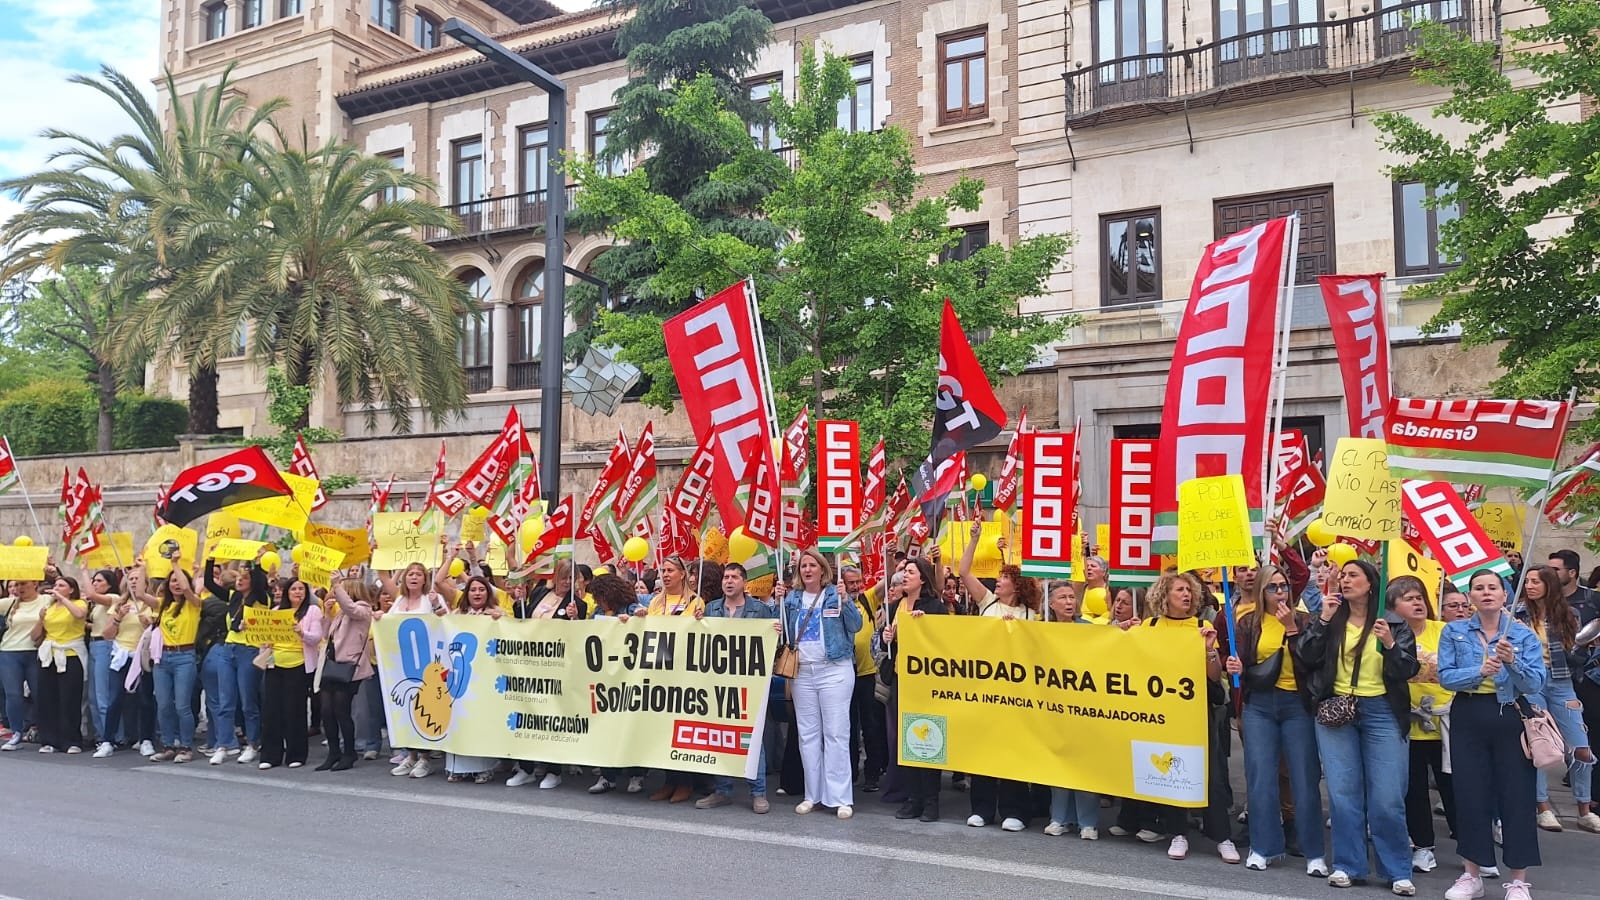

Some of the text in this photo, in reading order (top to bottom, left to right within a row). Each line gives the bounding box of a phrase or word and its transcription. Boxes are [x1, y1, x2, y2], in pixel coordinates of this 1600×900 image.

[826, 423, 853, 534] CCOO
[1032, 436, 1063, 557] CCOO
[1120, 443, 1152, 566] CCOO
[1402, 480, 1488, 569] COO
[406, 536, 421, 550] DE
[496, 638, 566, 659] EQUIPARACIÓN
[686, 632, 766, 677] LUCHA
[505, 675, 563, 696] NORMATIVA
[907, 655, 1196, 700] DIGNIDAD PARA EL 0-3
[715, 686, 748, 720] YA!
[932, 689, 1166, 725] PARA LA INFANCIA Y LAS TRABAJADORAS
[515, 712, 589, 735] DIGNIFICACIÓN
[677, 725, 736, 749] CCOO
[670, 749, 717, 765] Granada
